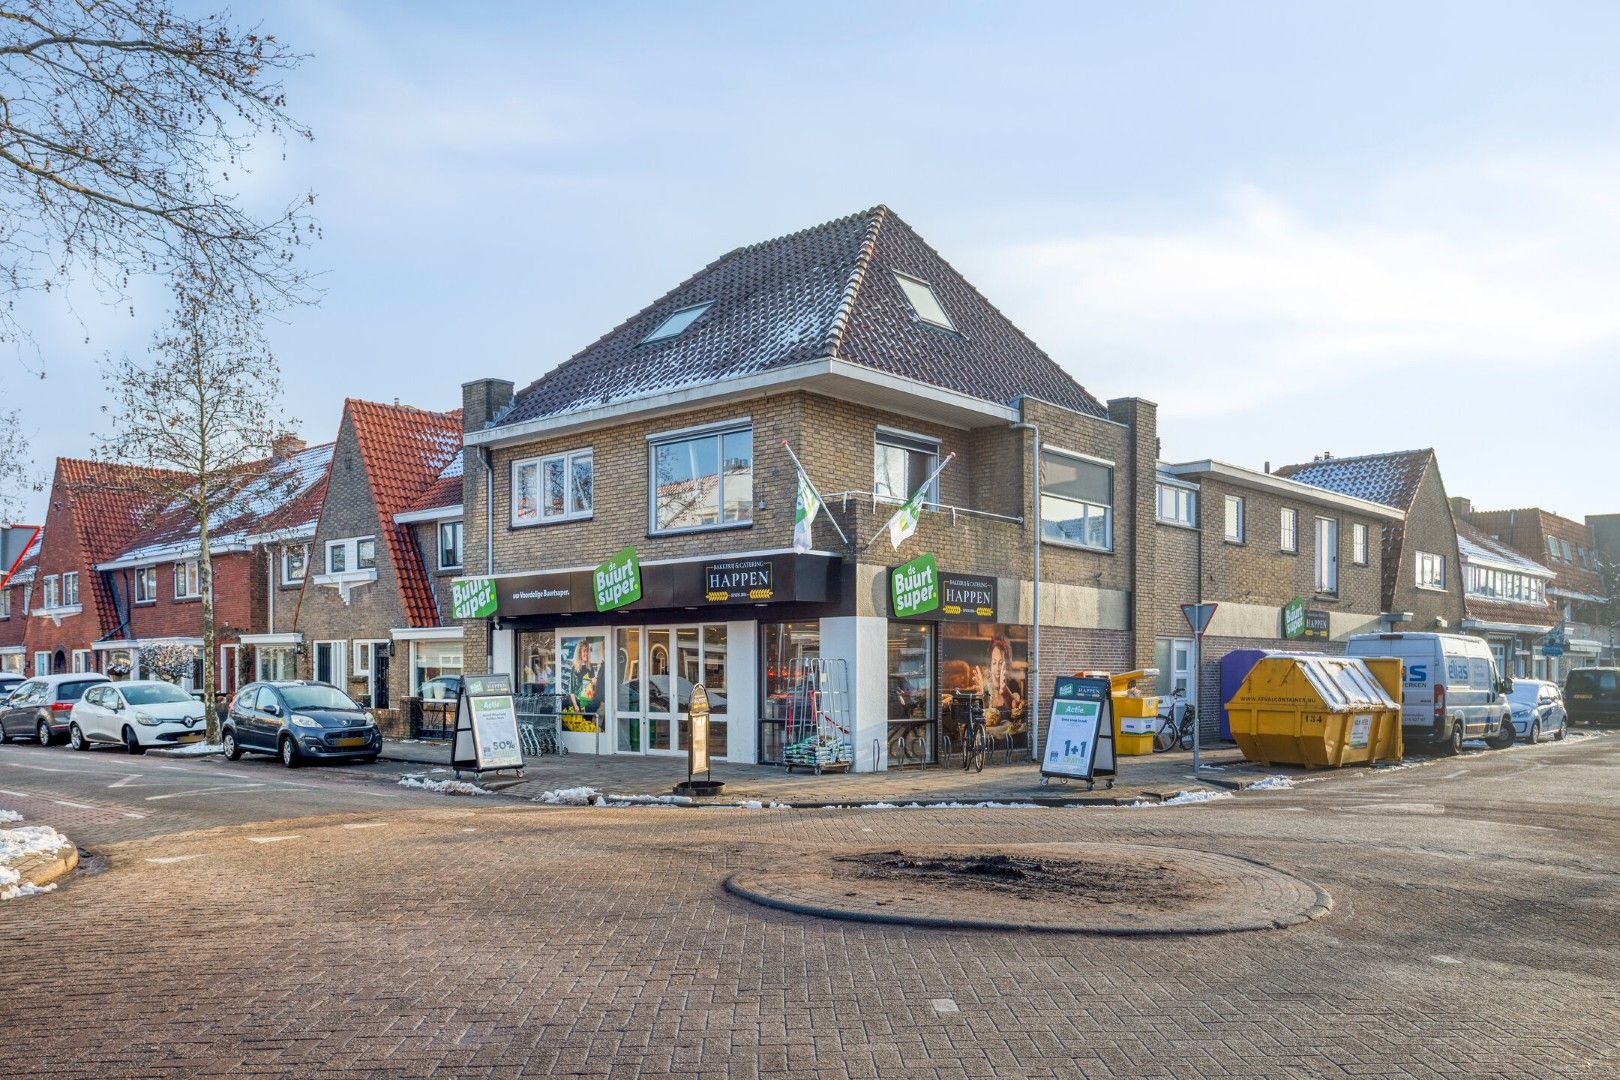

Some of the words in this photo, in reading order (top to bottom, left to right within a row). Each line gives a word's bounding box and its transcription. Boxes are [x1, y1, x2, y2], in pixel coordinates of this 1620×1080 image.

[596, 559, 634, 592] Buurt
[907, 565, 916, 574] de
[710, 571, 769, 588] HAPPEN
[895, 565, 933, 595] Buurt
[946, 588, 991, 605] HAPPEN
[1285, 604, 1303, 624] Buurt
[1306, 618, 1328, 629] HAPPEN
[1066, 705, 1084, 713] Actie
[493, 740, 516, 751] 50%
[1064, 740, 1087, 757] 1+1
